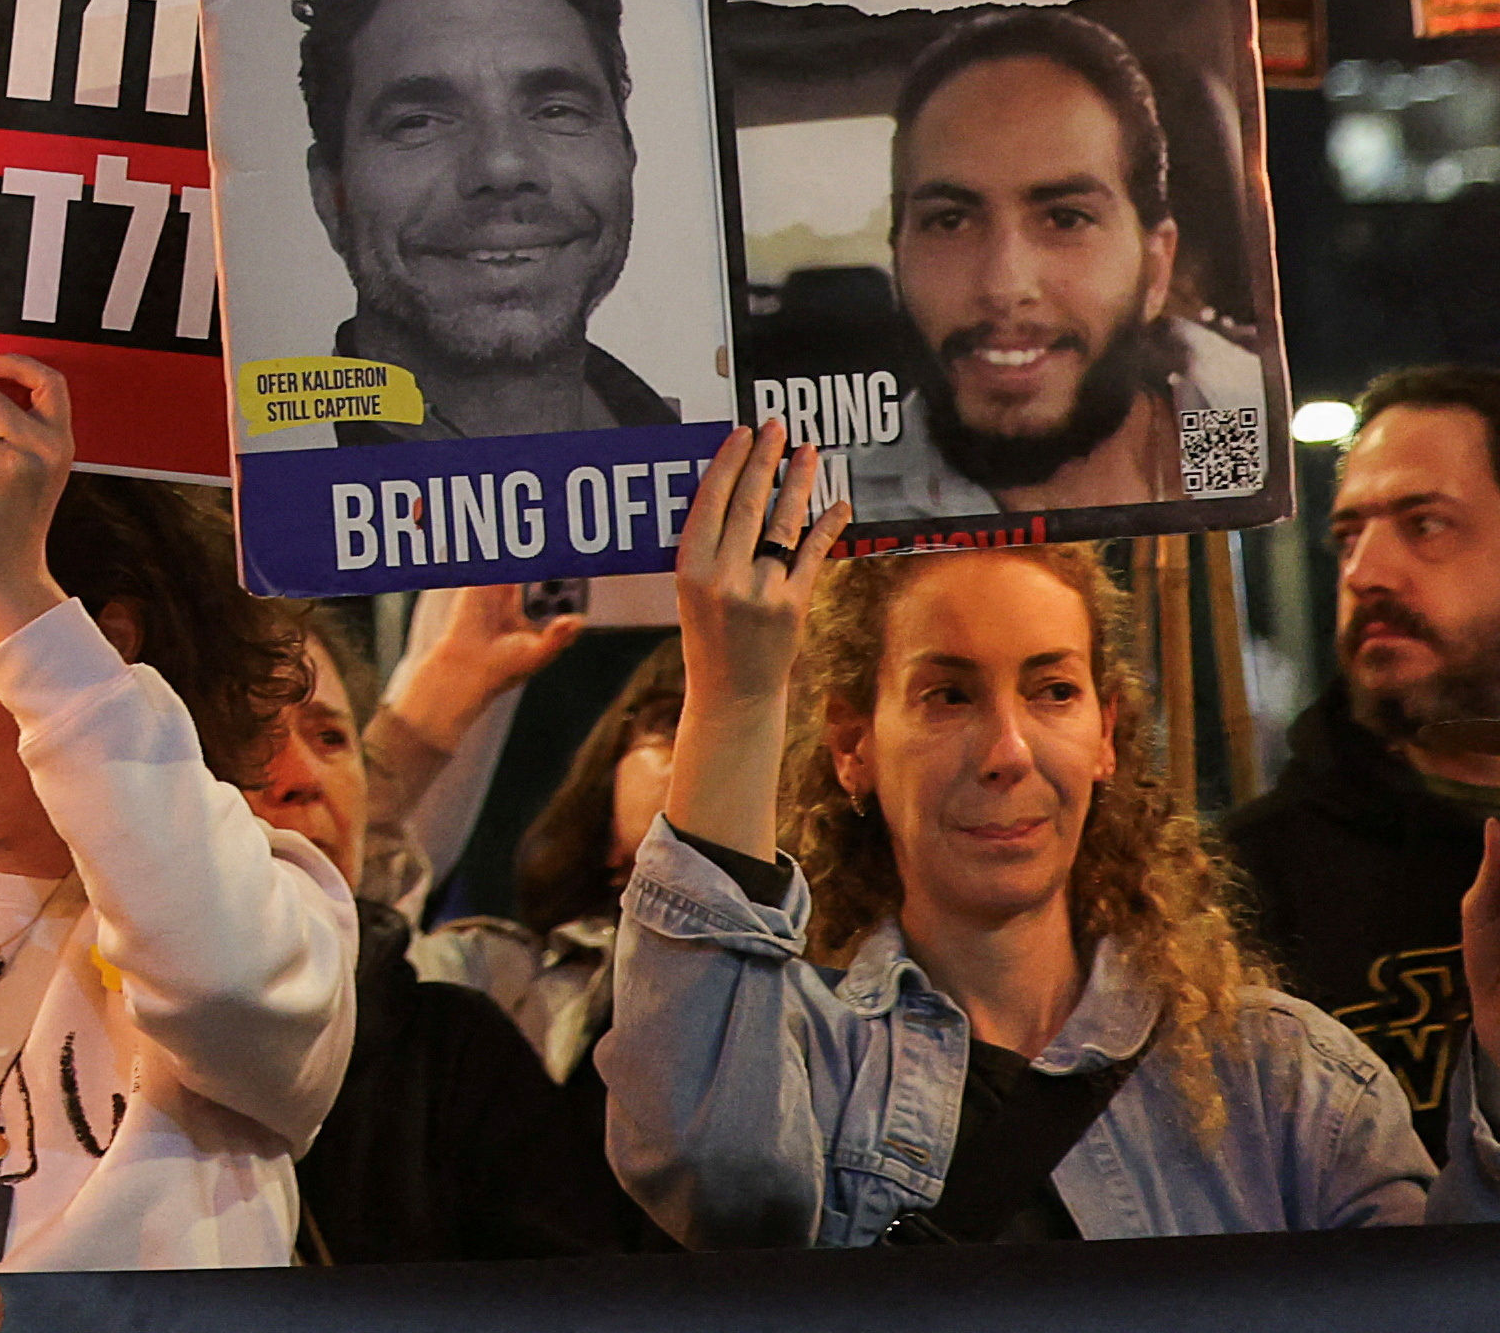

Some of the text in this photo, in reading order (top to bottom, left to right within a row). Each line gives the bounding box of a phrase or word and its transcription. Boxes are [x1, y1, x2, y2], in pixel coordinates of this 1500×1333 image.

[257, 366, 387, 394] OFER KALDERON
[267, 394, 381, 422] STILL CAPTIVE
[753, 370, 901, 449] BRING
[332, 470, 547, 571] BRING
[565, 458, 714, 554] OFE
